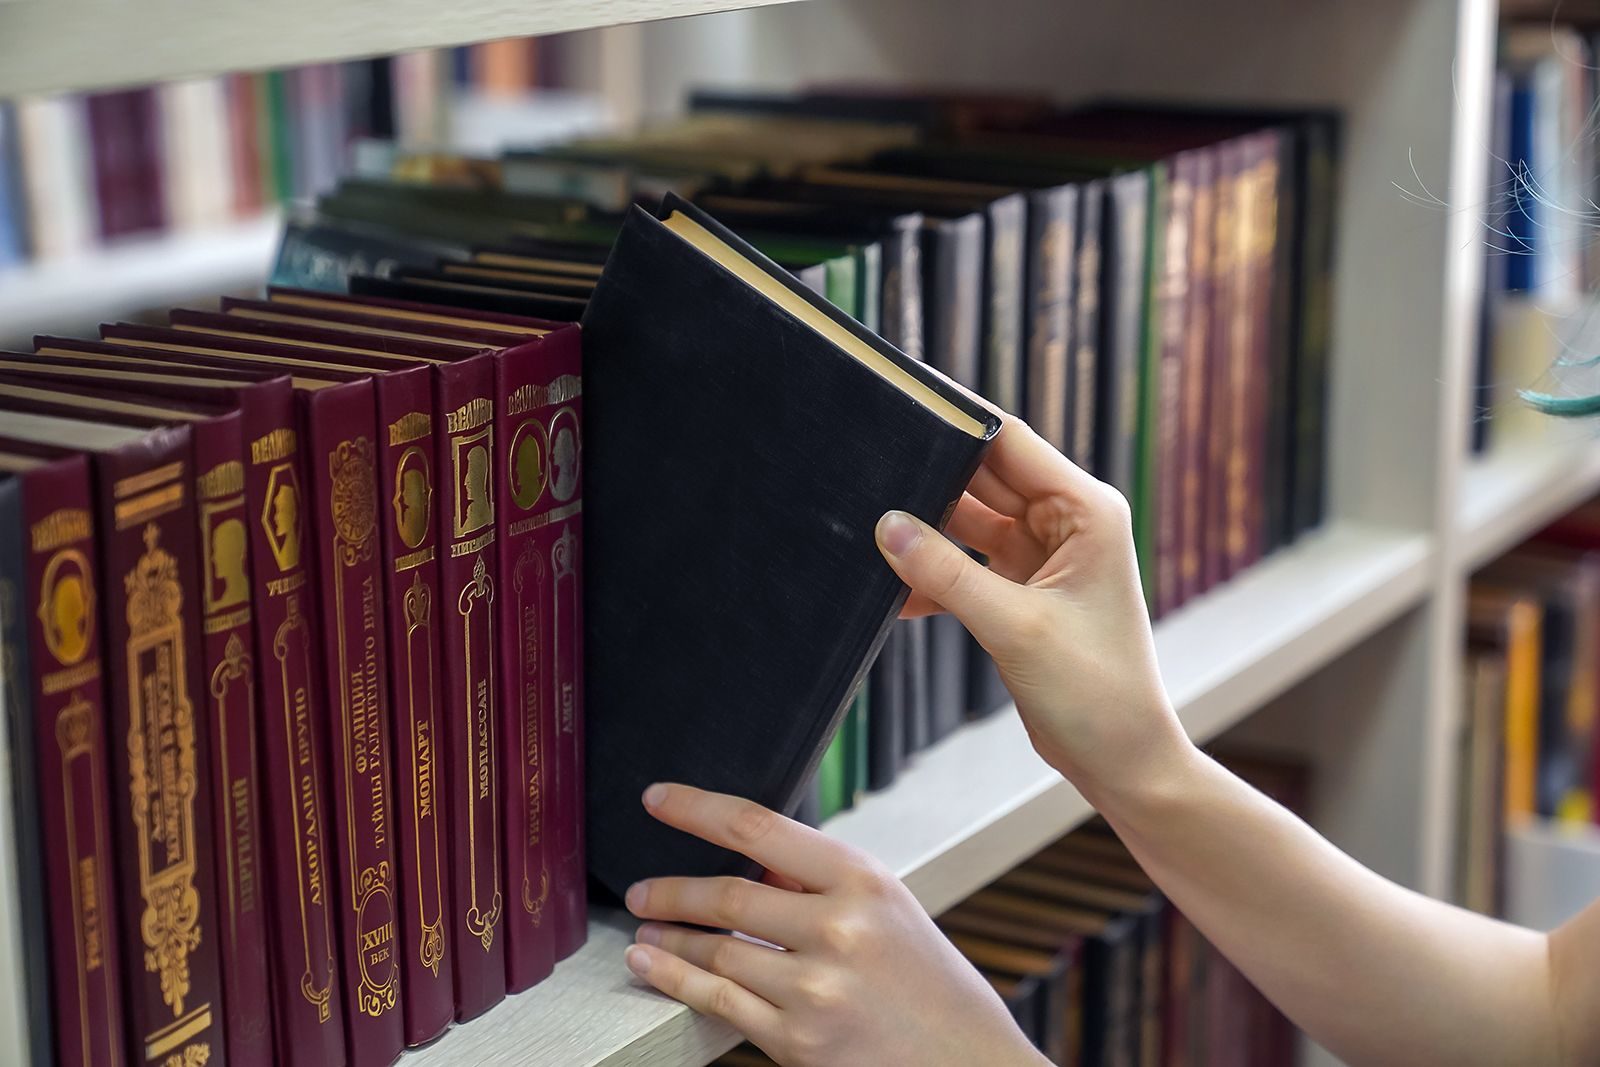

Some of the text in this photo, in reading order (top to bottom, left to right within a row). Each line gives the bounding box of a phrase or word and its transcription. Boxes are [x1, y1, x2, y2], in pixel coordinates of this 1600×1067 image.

[362, 575, 385, 849] ТАЙНЫ ГАЛАНТНОГО ВЕКА
[477, 679, 489, 800] МОПАССАН
[524, 604, 540, 848] РИЧАРД ЛЬВИНОЕ СЕРДЦЕ
[562, 681, 574, 734] ЛИСТ
[294, 687, 322, 907] ДЖОРДАНО БРУНО
[418, 720, 431, 819] МОЦАРТ
[362, 920, 393, 950] XVIII
[370, 948, 390, 966] ВЕК
